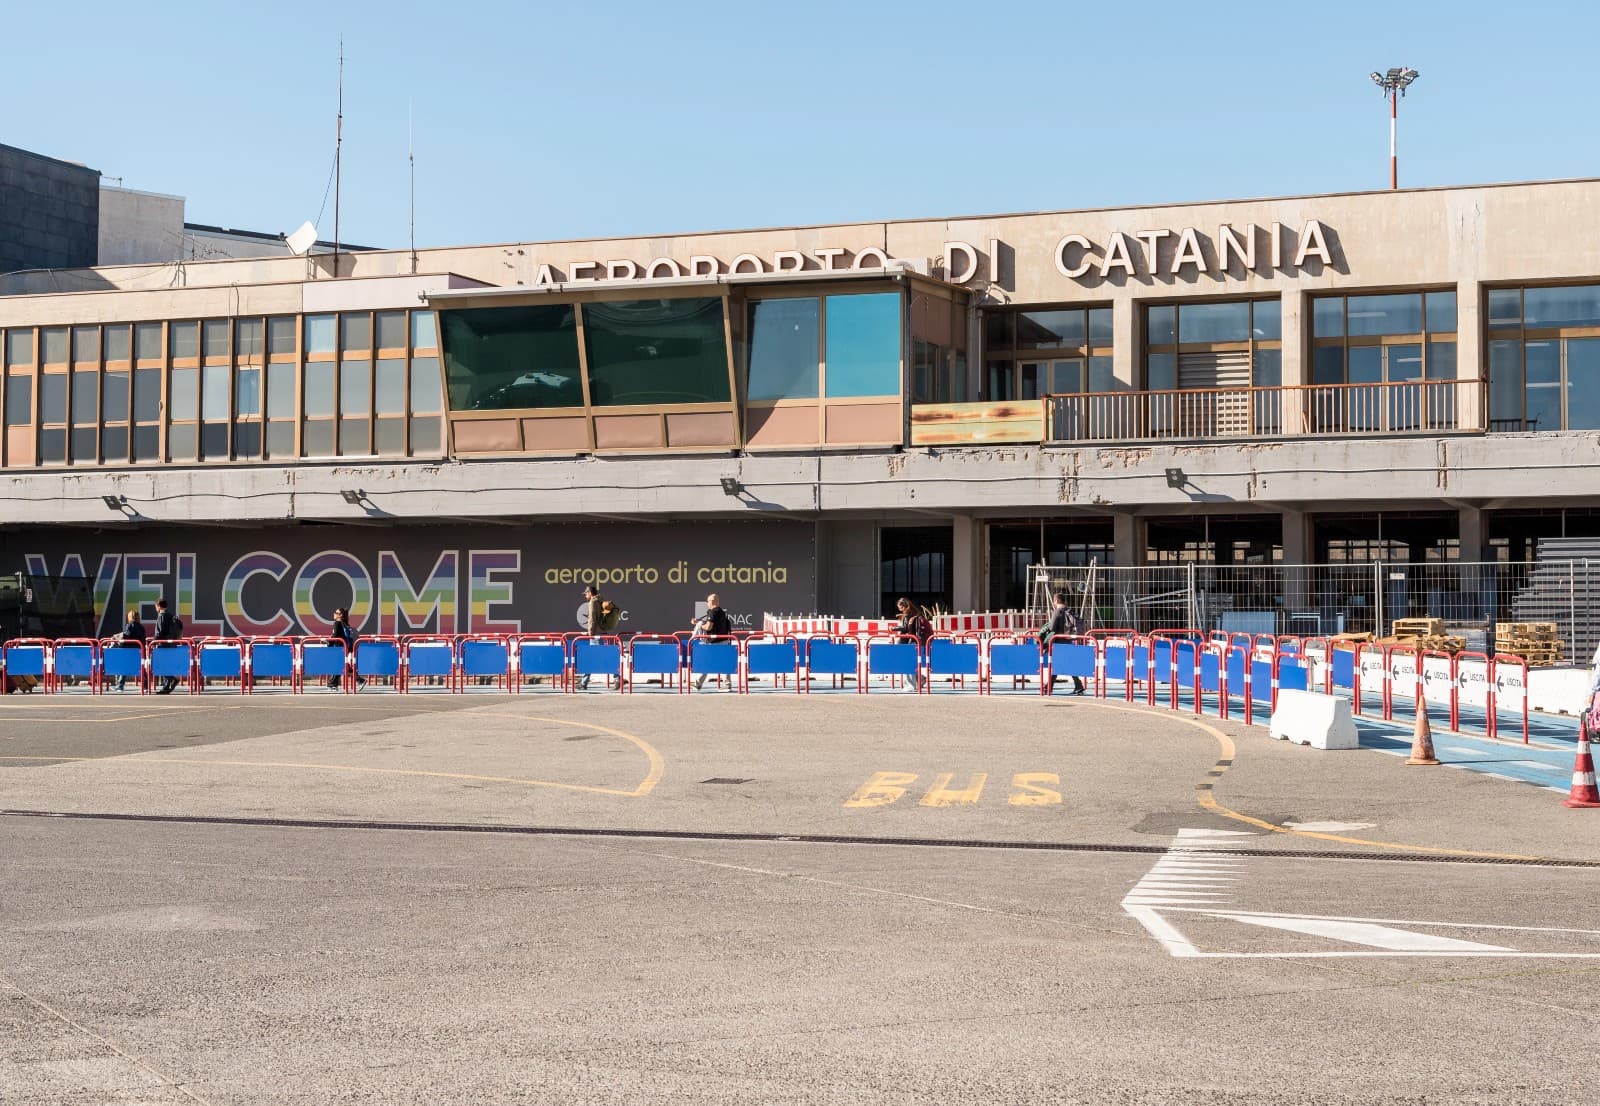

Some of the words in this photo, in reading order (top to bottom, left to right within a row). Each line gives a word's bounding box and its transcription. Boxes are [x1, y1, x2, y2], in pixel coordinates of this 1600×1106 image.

[943, 238, 999, 284] DI
[1053, 219, 1333, 279] CATANIA
[544, 563, 659, 589] aeroporto
[667, 561, 689, 584] di
[697, 561, 787, 584] catania
[25, 550, 522, 635] WELCOME
[726, 613, 753, 626] NAC
[1433, 671, 1449, 680] USCITA
[1469, 673, 1486, 682] USCITA
[1506, 676, 1522, 687] USCITA
[842, 771, 1063, 808] BUS
